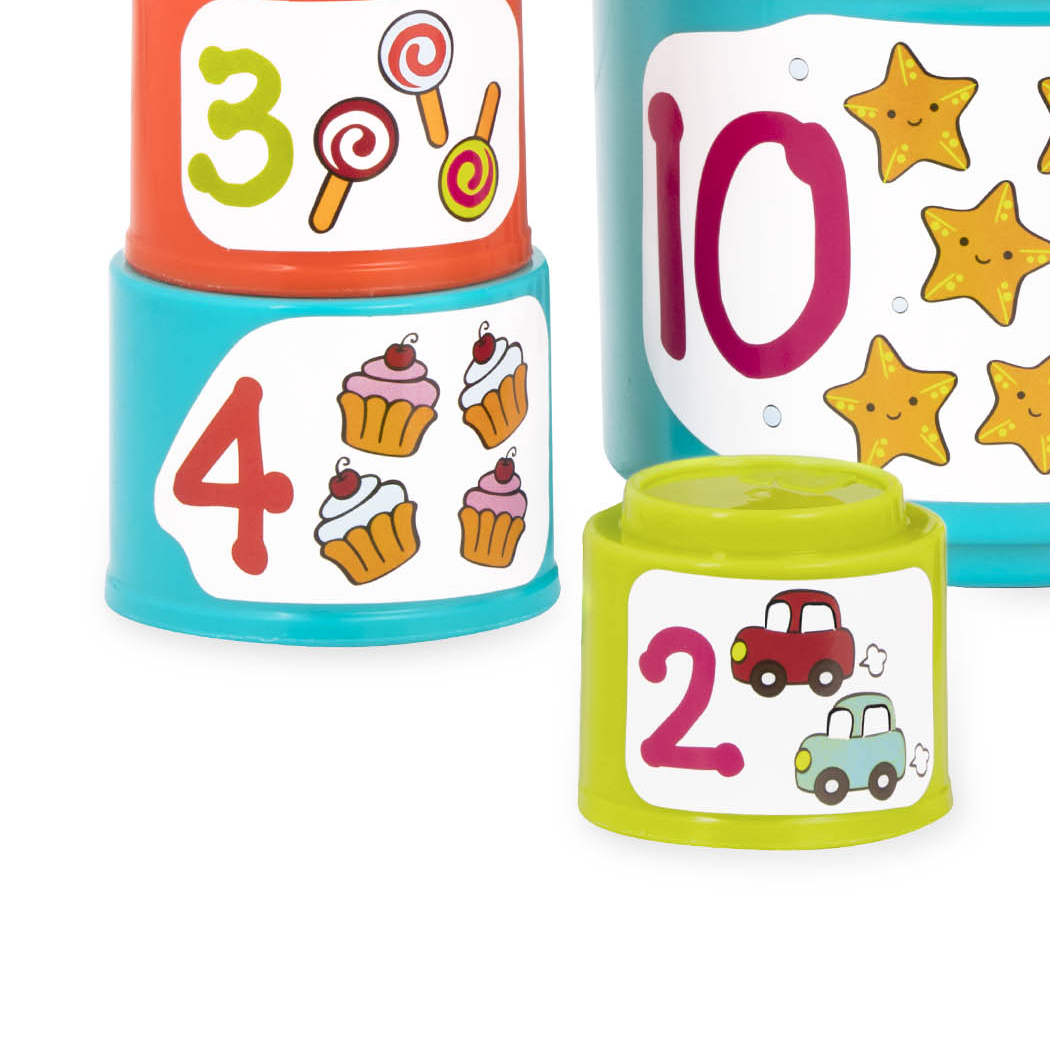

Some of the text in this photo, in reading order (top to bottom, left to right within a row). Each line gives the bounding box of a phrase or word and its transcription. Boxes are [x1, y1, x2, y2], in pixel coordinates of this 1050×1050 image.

[187, 45, 294, 208] 3
[647, 92, 851, 379] 10
[173, 376, 294, 576] 4
[639, 626, 745, 778] 2
